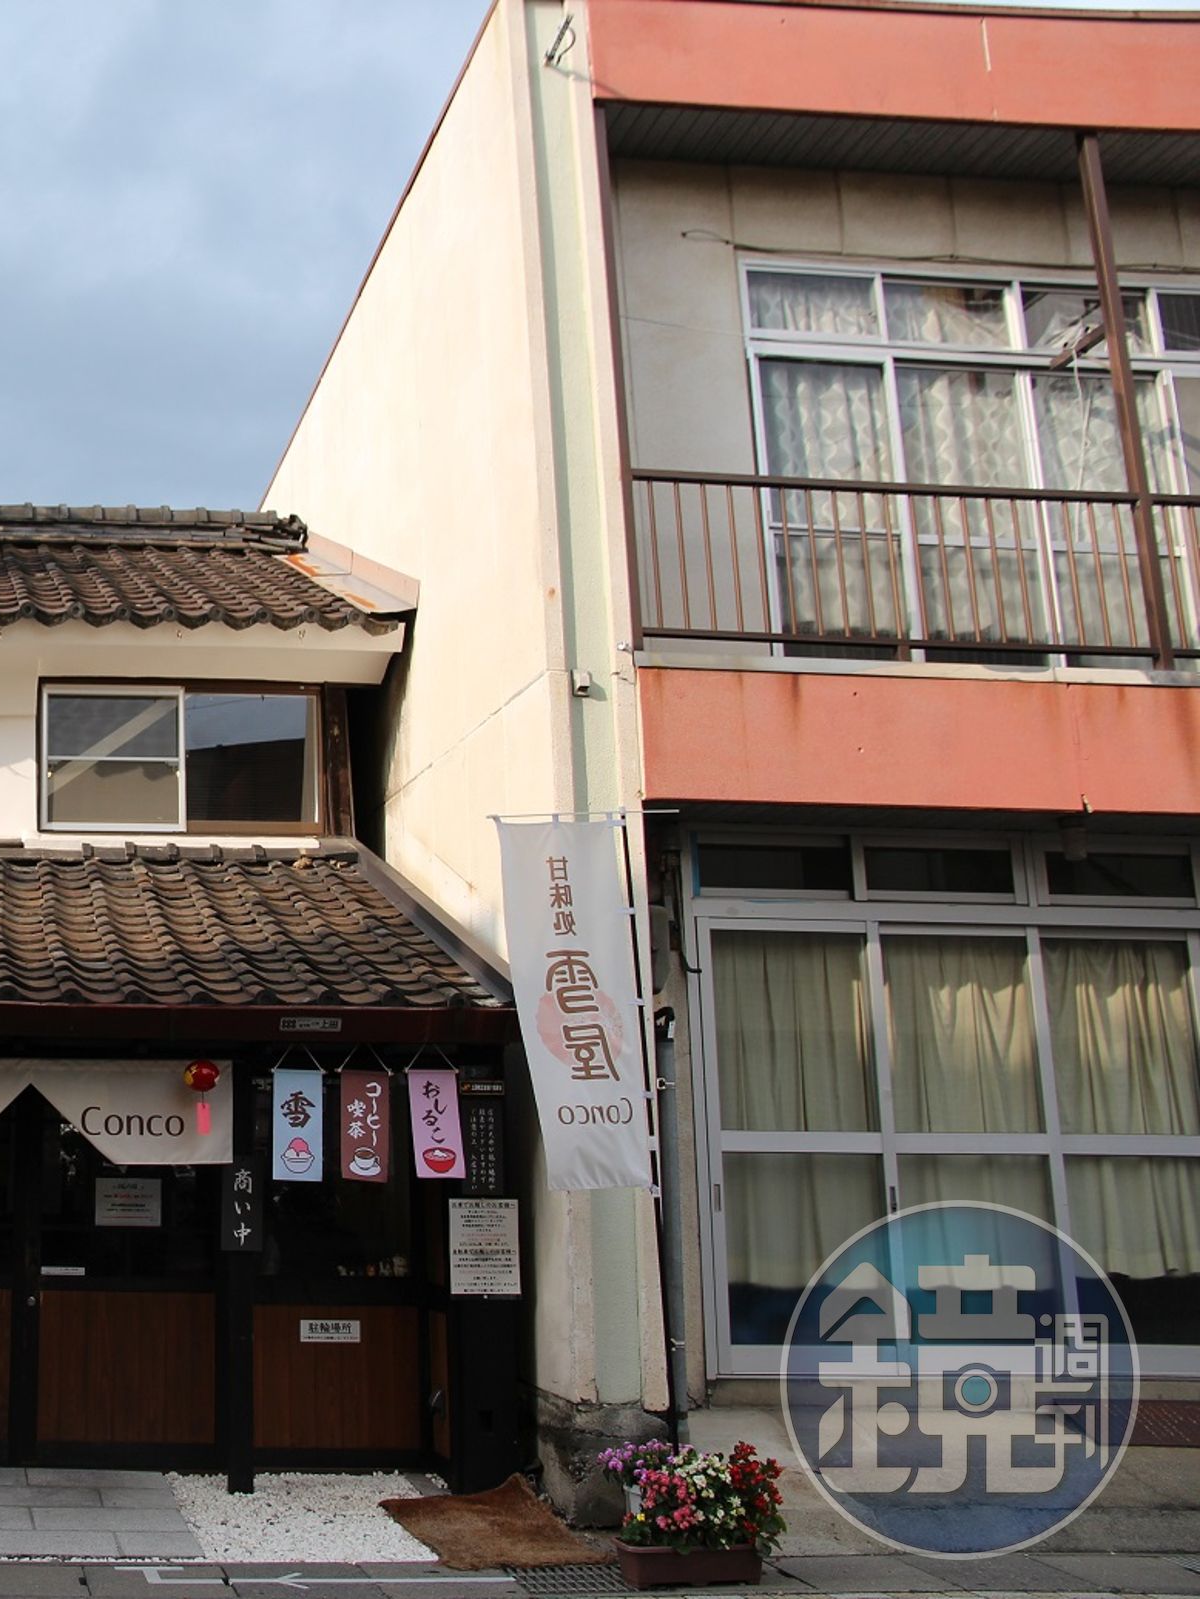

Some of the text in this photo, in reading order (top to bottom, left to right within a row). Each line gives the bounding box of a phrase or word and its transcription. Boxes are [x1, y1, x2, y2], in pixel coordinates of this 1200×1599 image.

[81, 1106, 185, 1136] Conco
[280, 1090, 316, 1129] 雪
[347, 1100, 366, 1139] 喫茶
[366, 1082, 382, 1147] コーヒー
[422, 1080, 447, 1144] おしるこ
[233, 1169, 253, 1246] 商い中
